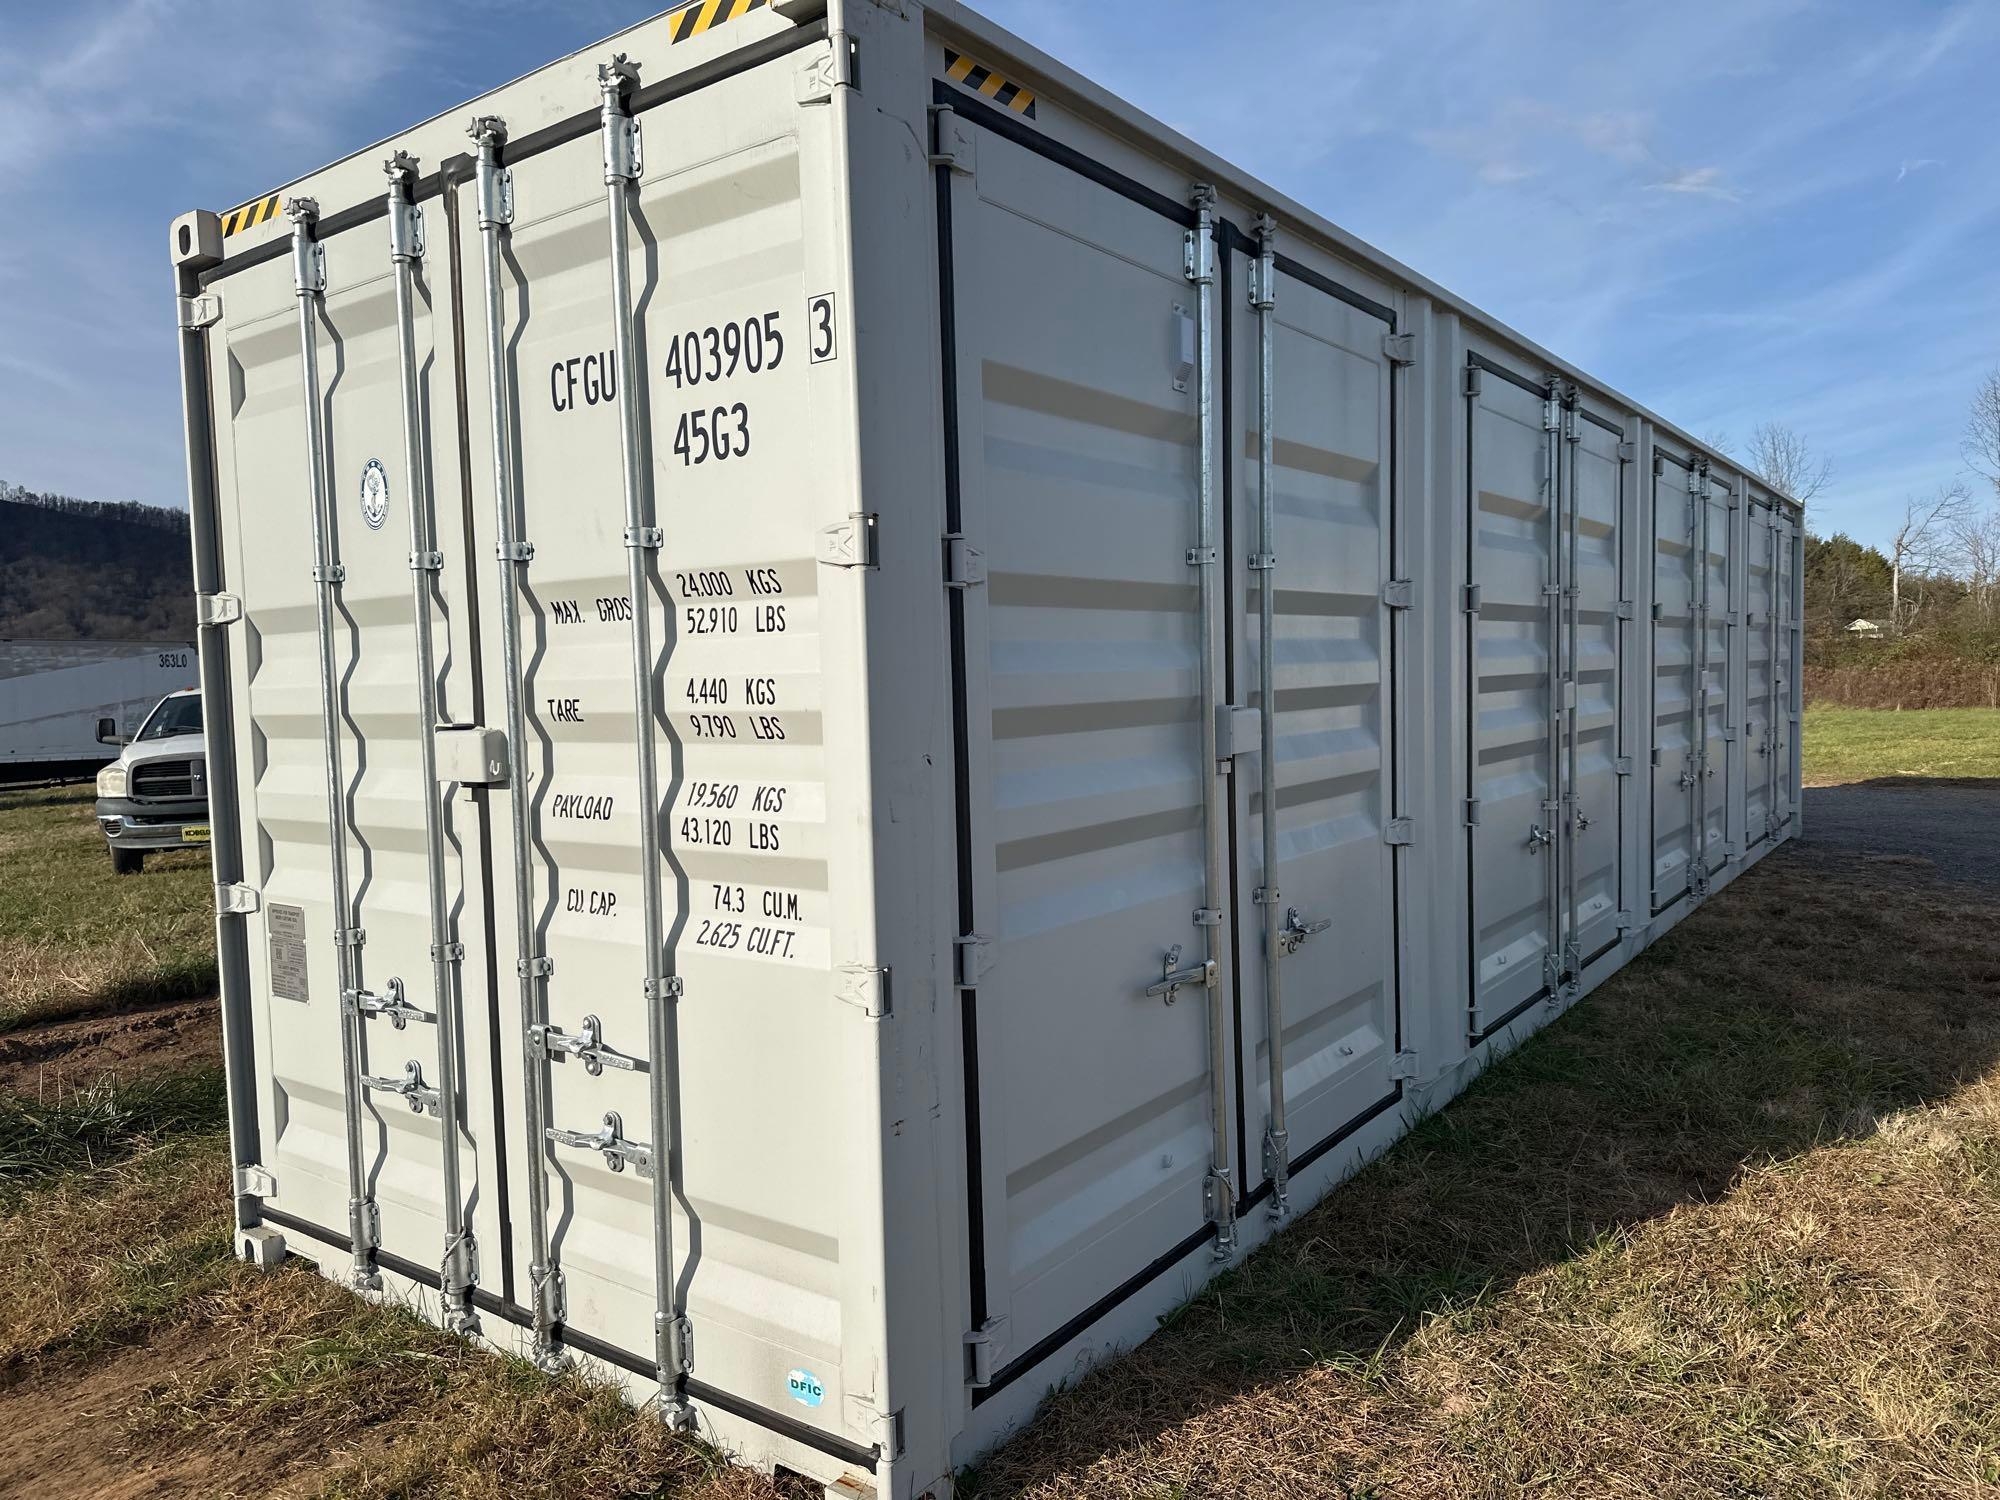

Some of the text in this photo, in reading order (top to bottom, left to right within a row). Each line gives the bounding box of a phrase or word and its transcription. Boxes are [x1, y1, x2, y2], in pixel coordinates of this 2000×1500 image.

[551, 298, 833, 412] CFGU 403905 3
[673, 402, 750, 467] 45G3
[745, 568, 782, 595] KGS
[550, 597, 632, 624] MAX. GROS
[687, 605, 786, 634] 52,910 LBS
[686, 677, 776, 705] 4,440 KGS
[547, 699, 584, 722] TARE
[749, 716, 785, 740] LBS
[552, 794, 614, 820] PAYLOAD
[687, 782, 787, 813] 19,560 KGS
[749, 822, 779, 851] LBS
[567, 888, 617, 917] CU. CAP.
[713, 884, 802, 922] 74.3 CU.M.
[696, 919, 796, 959] 2,625 CU.FT.
[790, 1378, 822, 1397] DFIC
